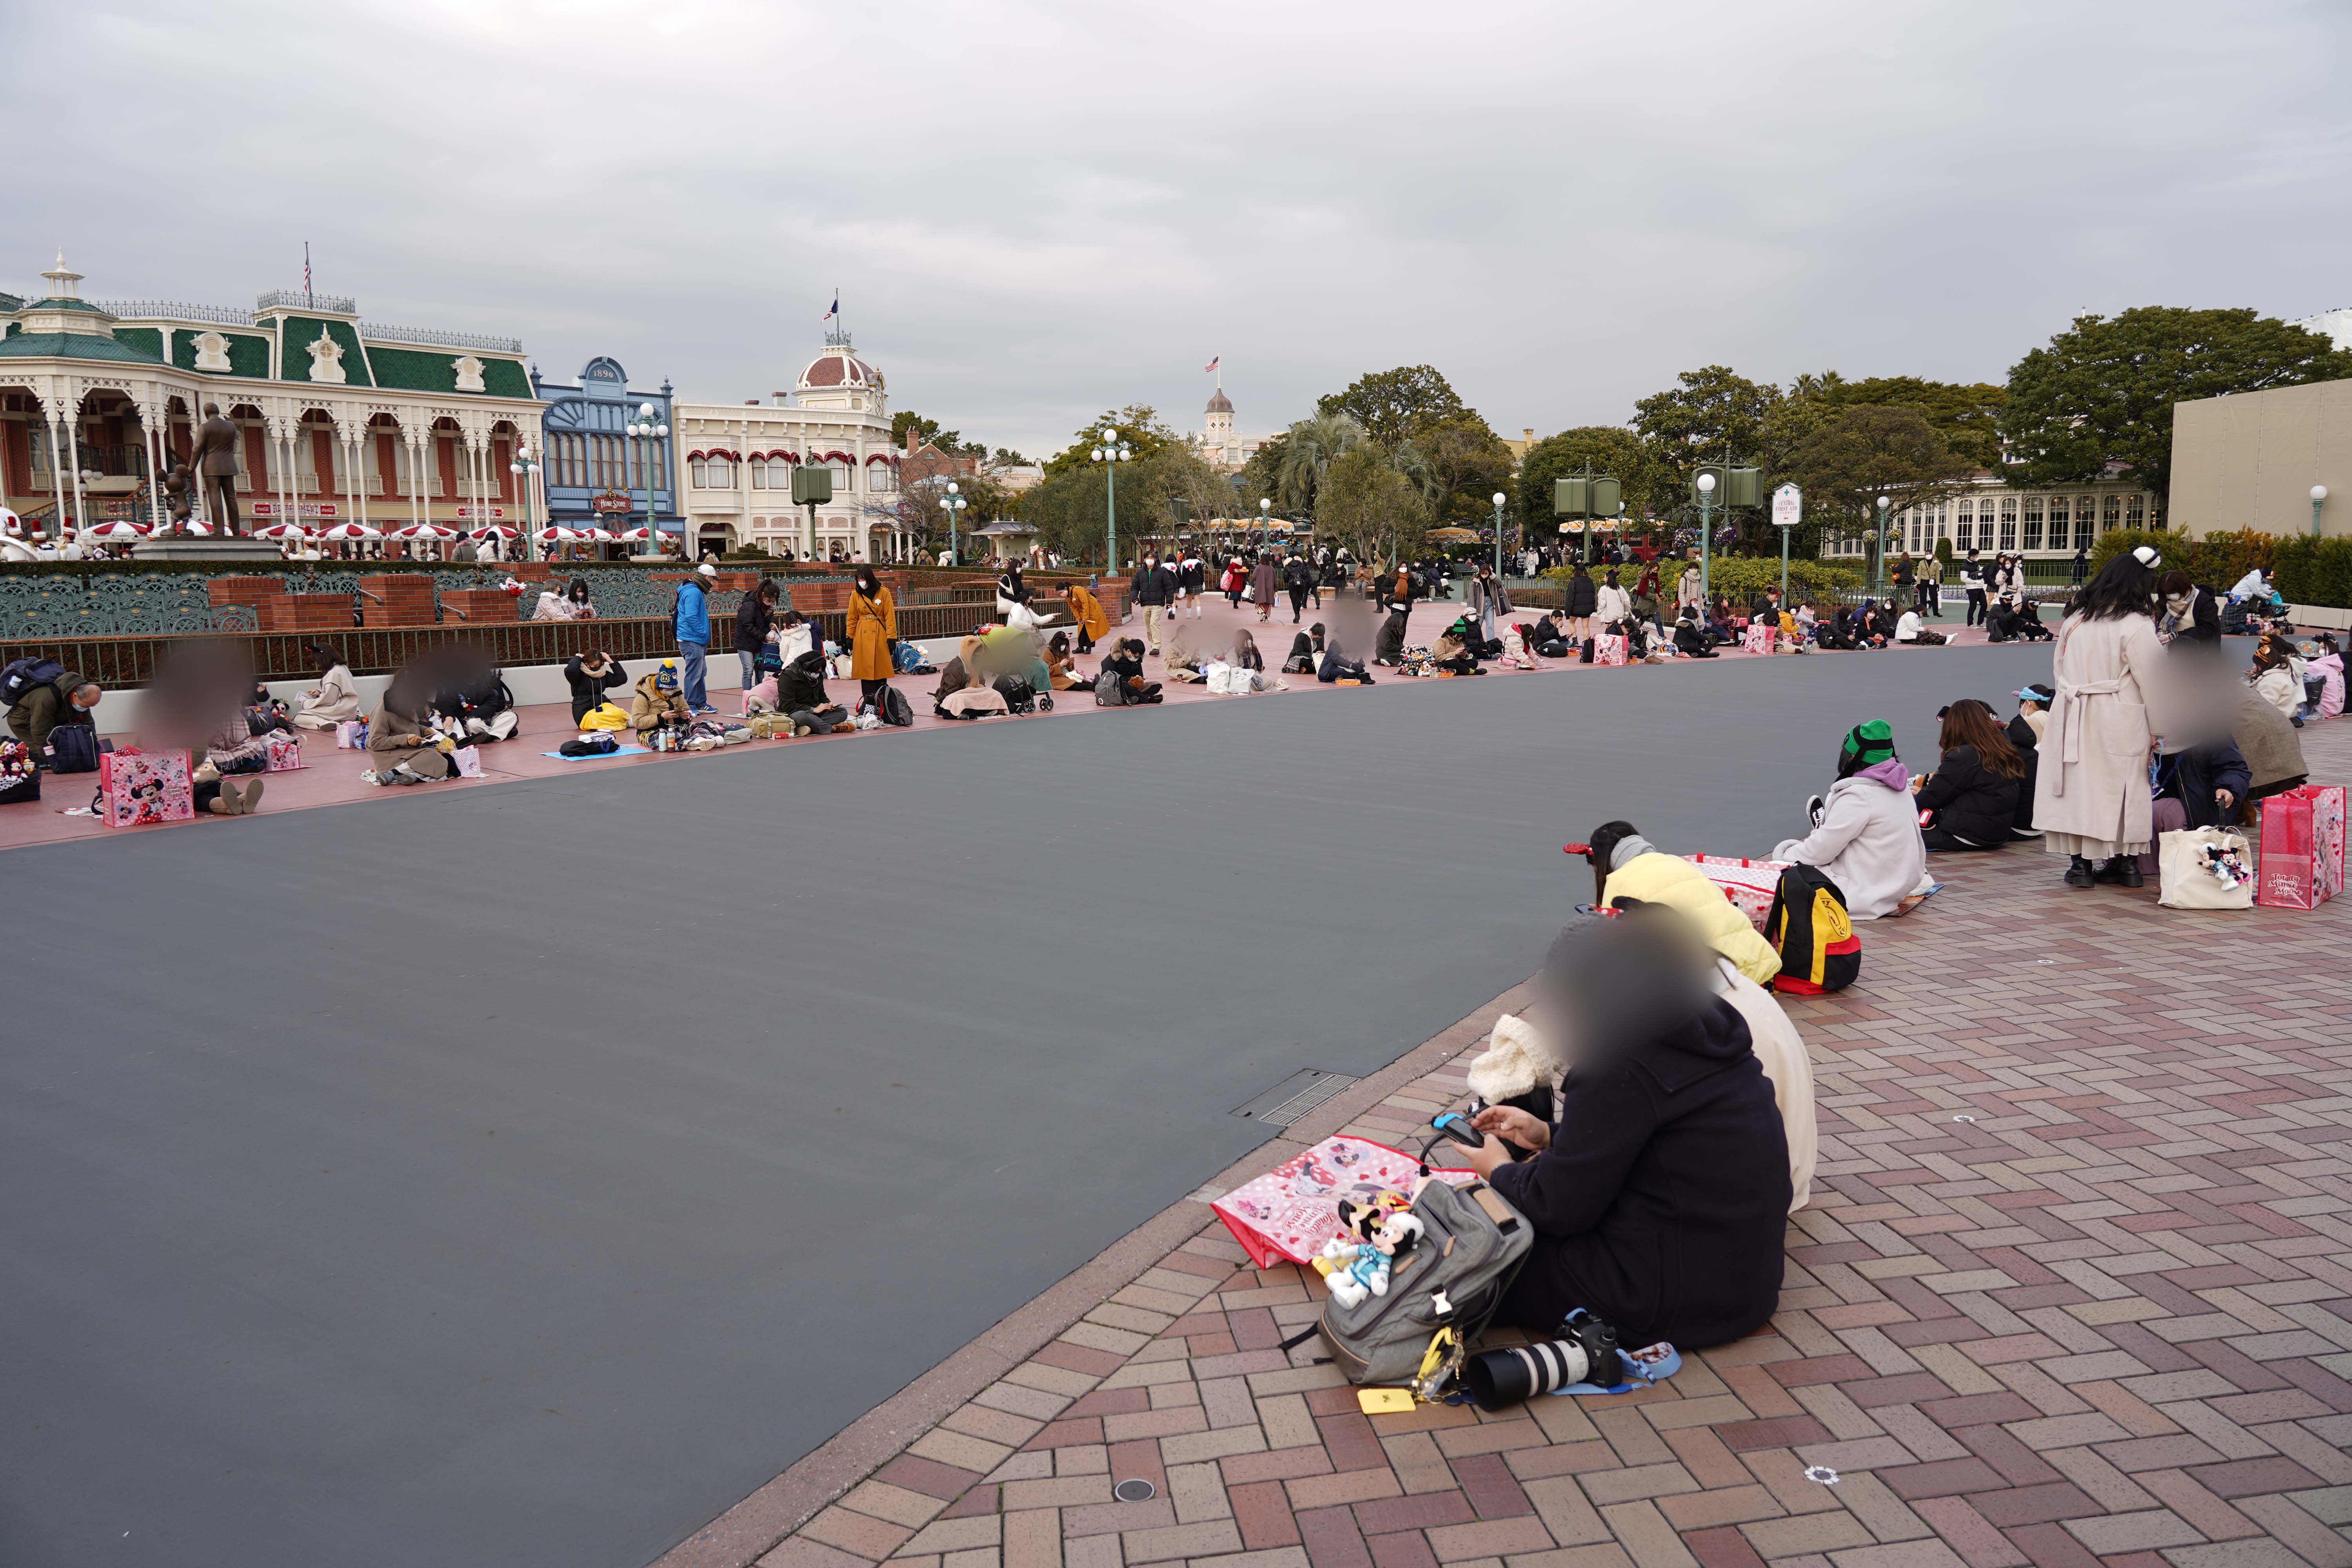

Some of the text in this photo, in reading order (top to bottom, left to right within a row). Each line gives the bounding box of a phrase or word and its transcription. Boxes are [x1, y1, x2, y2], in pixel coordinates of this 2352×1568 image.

[593, 370, 613, 378] 1890
[600, 499, 626, 509] HOME STORE
[2271, 873, 2300, 884] Totally
[2267, 880, 2297, 889] Minnie
[2274, 888, 2303, 896] Mouse
[1283, 1201, 1311, 1231] Mouse
[1297, 1201, 1330, 1229] Minnie
[1304, 1212, 1335, 1236] Totally
